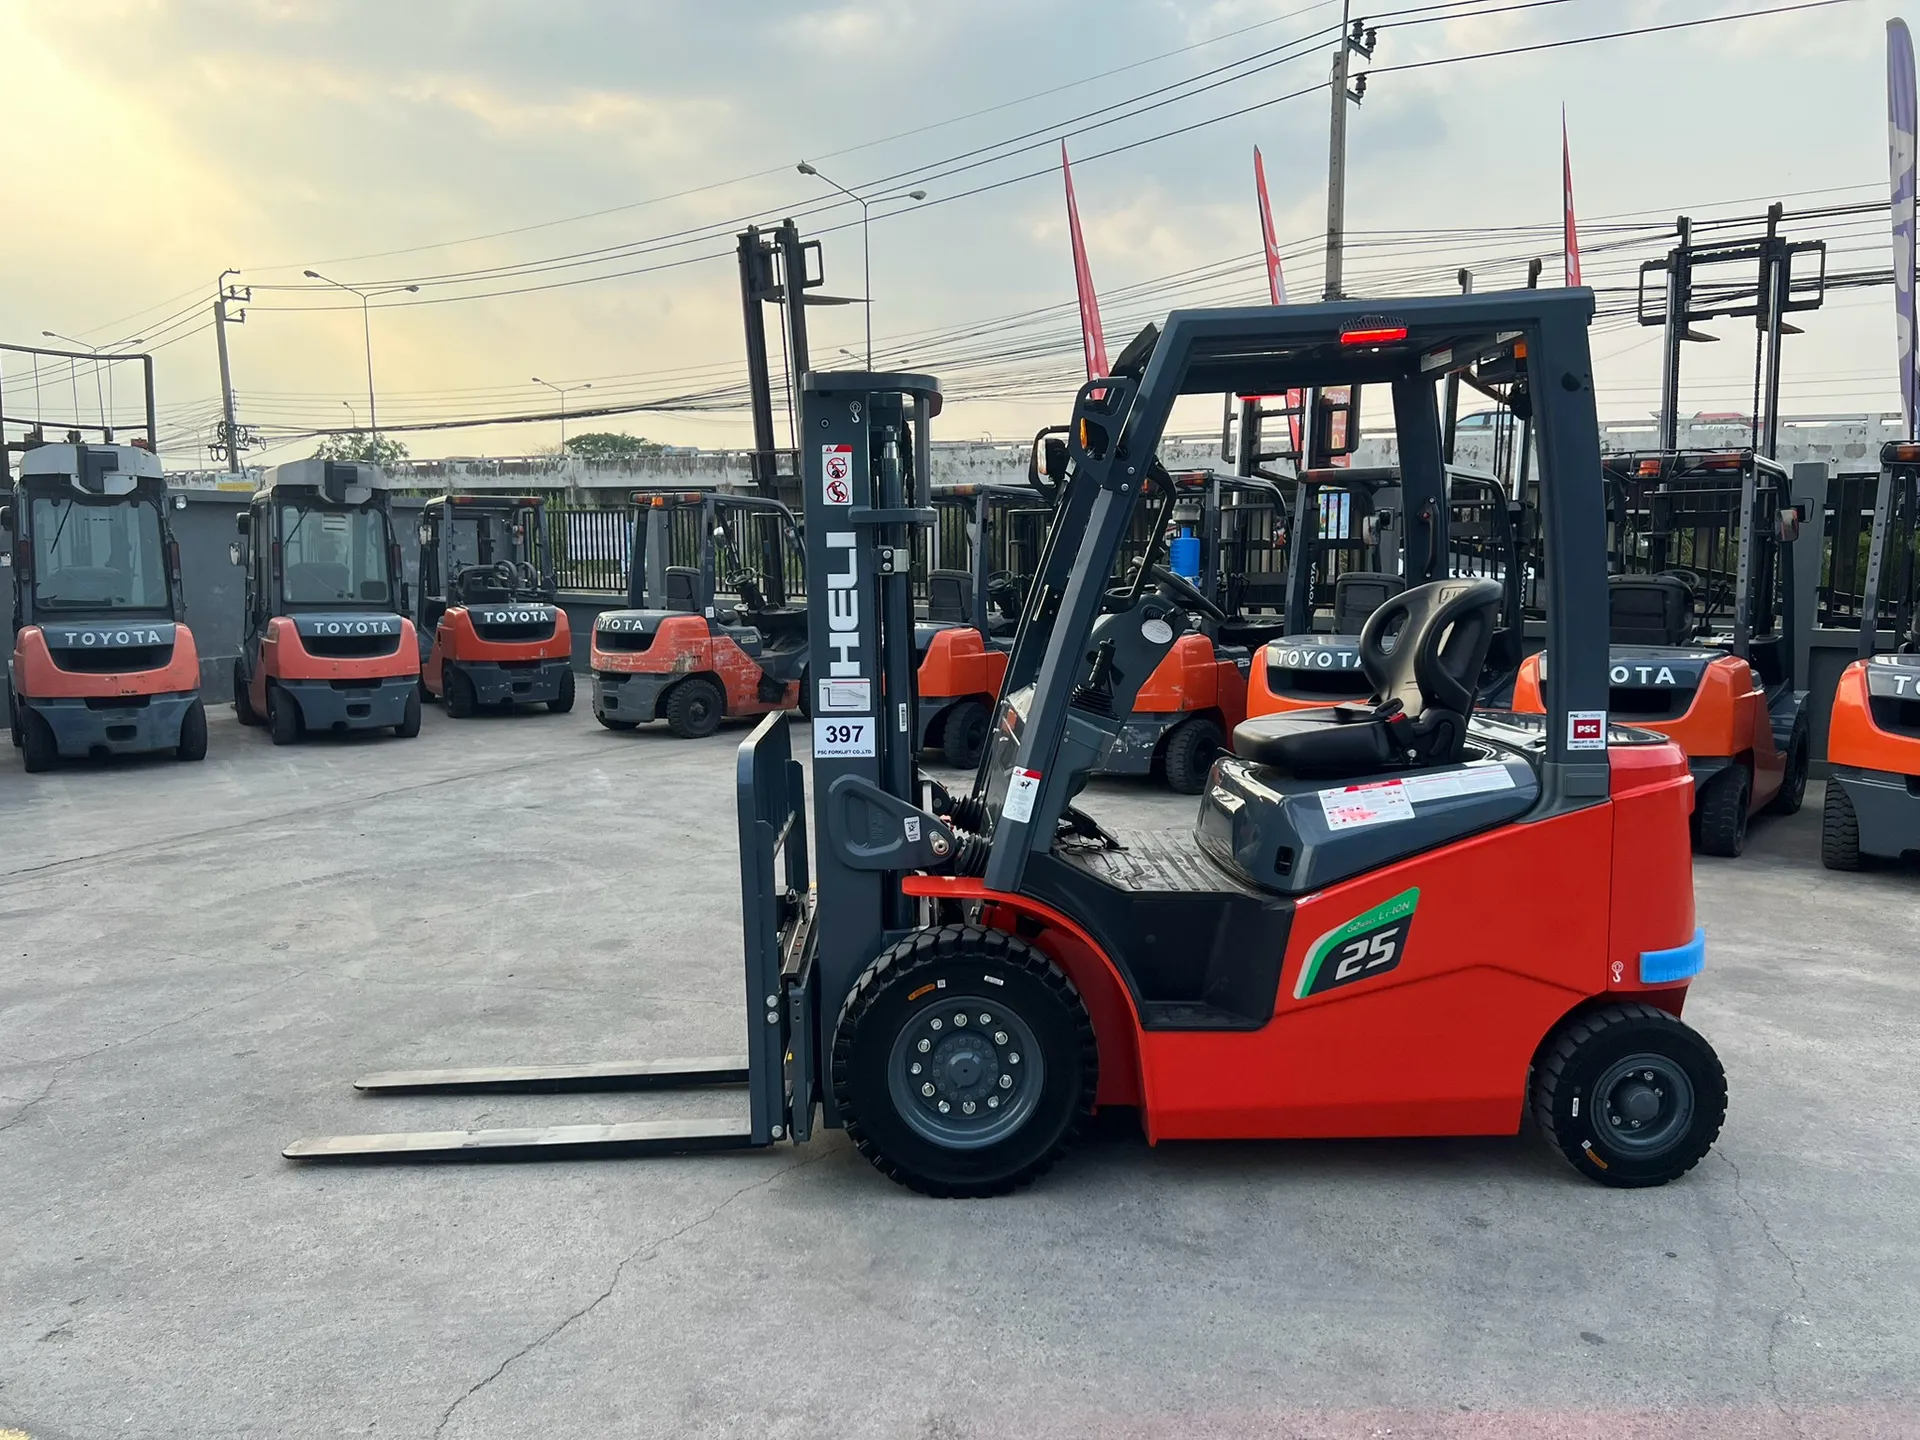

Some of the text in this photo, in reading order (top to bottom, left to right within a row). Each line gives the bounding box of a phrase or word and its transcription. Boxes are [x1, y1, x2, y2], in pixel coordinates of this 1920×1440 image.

[1308, 561, 1317, 607] TOYOTA
[1519, 561, 1528, 610] TOYOTA
[826, 531, 861, 677] HELI
[484, 610, 549, 623] TOYOTA
[313, 621, 392, 634] TOYOTA
[64, 630, 161, 646] TOYOTA
[1237, 657, 1251, 668] 25
[1610, 665, 1676, 684] OTA
[825, 725, 864, 743] 397
[1577, 725, 1597, 734] PSC
[1335, 926, 1400, 980] 25
